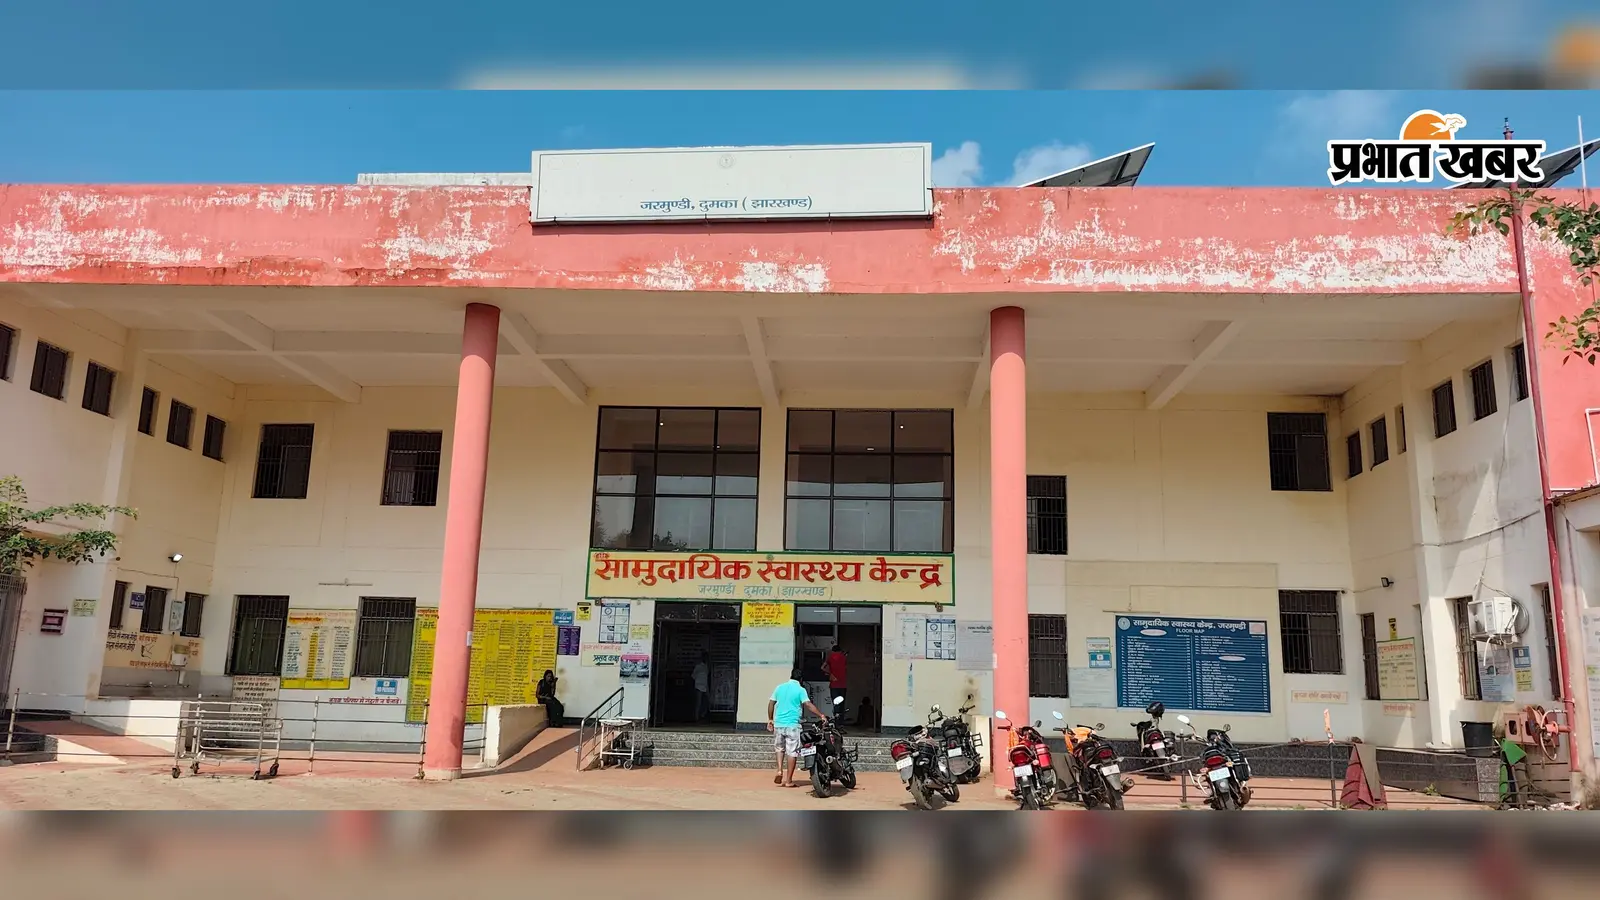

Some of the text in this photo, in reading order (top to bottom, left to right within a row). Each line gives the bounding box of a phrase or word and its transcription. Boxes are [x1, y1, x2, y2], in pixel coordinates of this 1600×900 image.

[640, 197, 695, 213] जरमुण्डी,
[699, 198, 738, 213] दुमका
[594, 553, 944, 590] सामुदायिक स्वास्थ्य केन्द्र
[697, 582, 736, 597] जरमुण्डी
[743, 584, 773, 598] दुमका
[1133, 618, 1169, 629] सामुदायिक
[1171, 620, 1196, 628] स्वास्थ्य
[1217, 621, 1247, 632] जरमुण्डी
